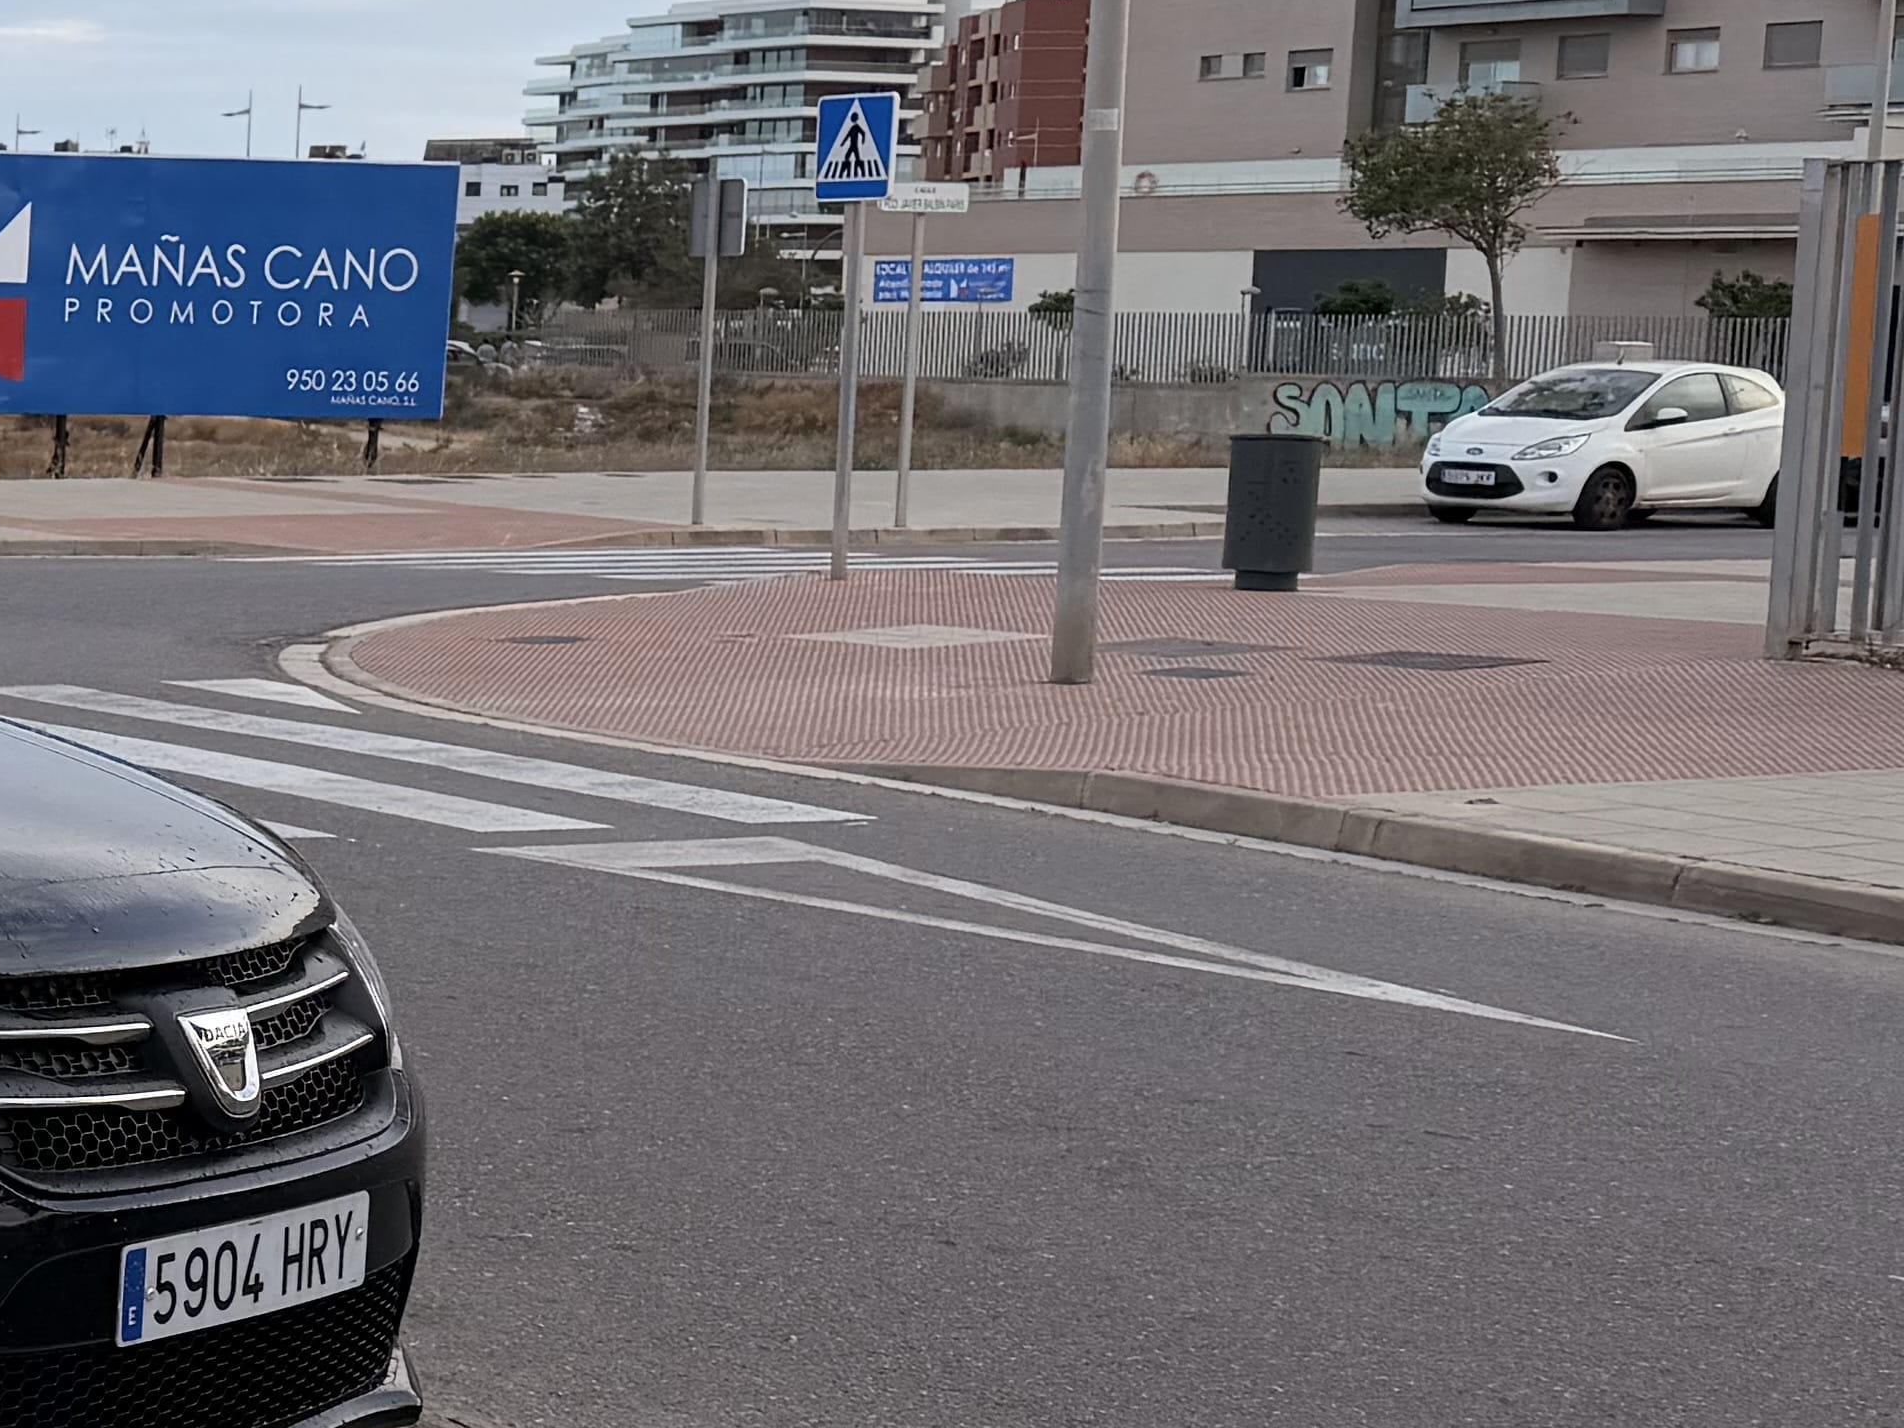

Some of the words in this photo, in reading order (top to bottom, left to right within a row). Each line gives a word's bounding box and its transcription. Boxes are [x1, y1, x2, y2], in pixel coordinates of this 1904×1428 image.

[65, 234, 246, 289] MAÑAS
[264, 245, 419, 292] CANO
[64, 297, 370, 328] PROMOTORA
[286, 368, 326, 391] 950
[331, 369, 357, 392] 23
[362, 370, 389, 392] 05
[395, 371, 420, 393] 66
[204, 1022, 246, 1042] DACIA
[153, 1233, 264, 1325] 5904
[281, 1210, 353, 1296] HRY
[128, 1306, 137, 1326] E
